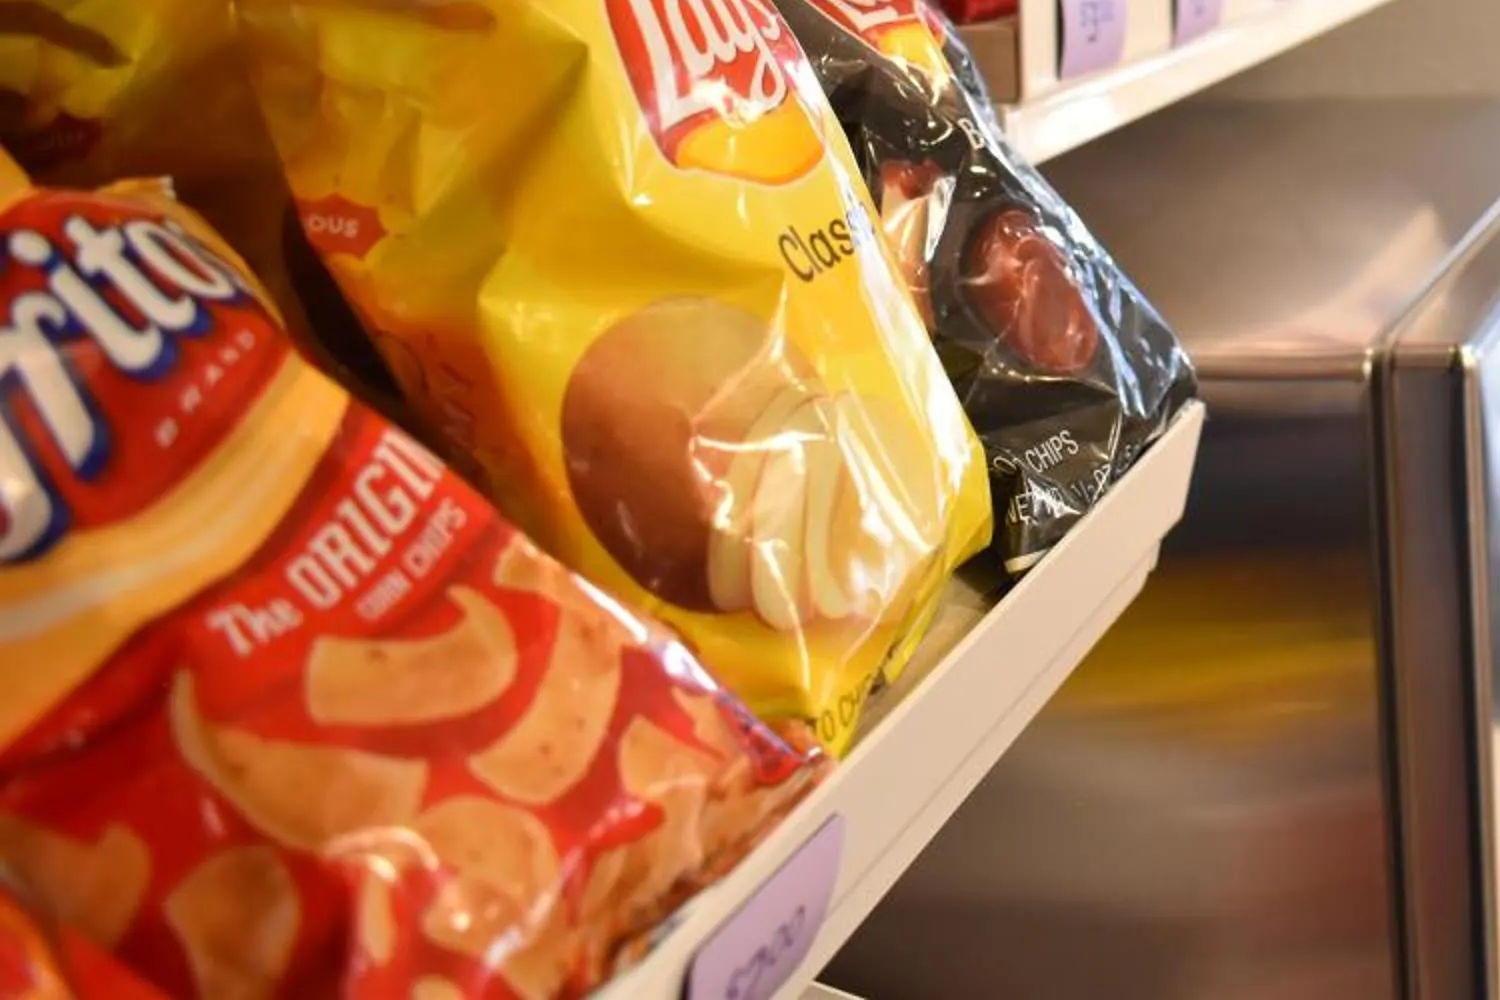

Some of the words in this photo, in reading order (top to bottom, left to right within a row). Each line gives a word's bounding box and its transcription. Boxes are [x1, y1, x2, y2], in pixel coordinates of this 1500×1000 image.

[0, 214, 250, 562] rito
[1025, 429, 1080, 474] CHIPS
[402, 496, 469, 580] CHIPS
[205, 599, 304, 658] The
